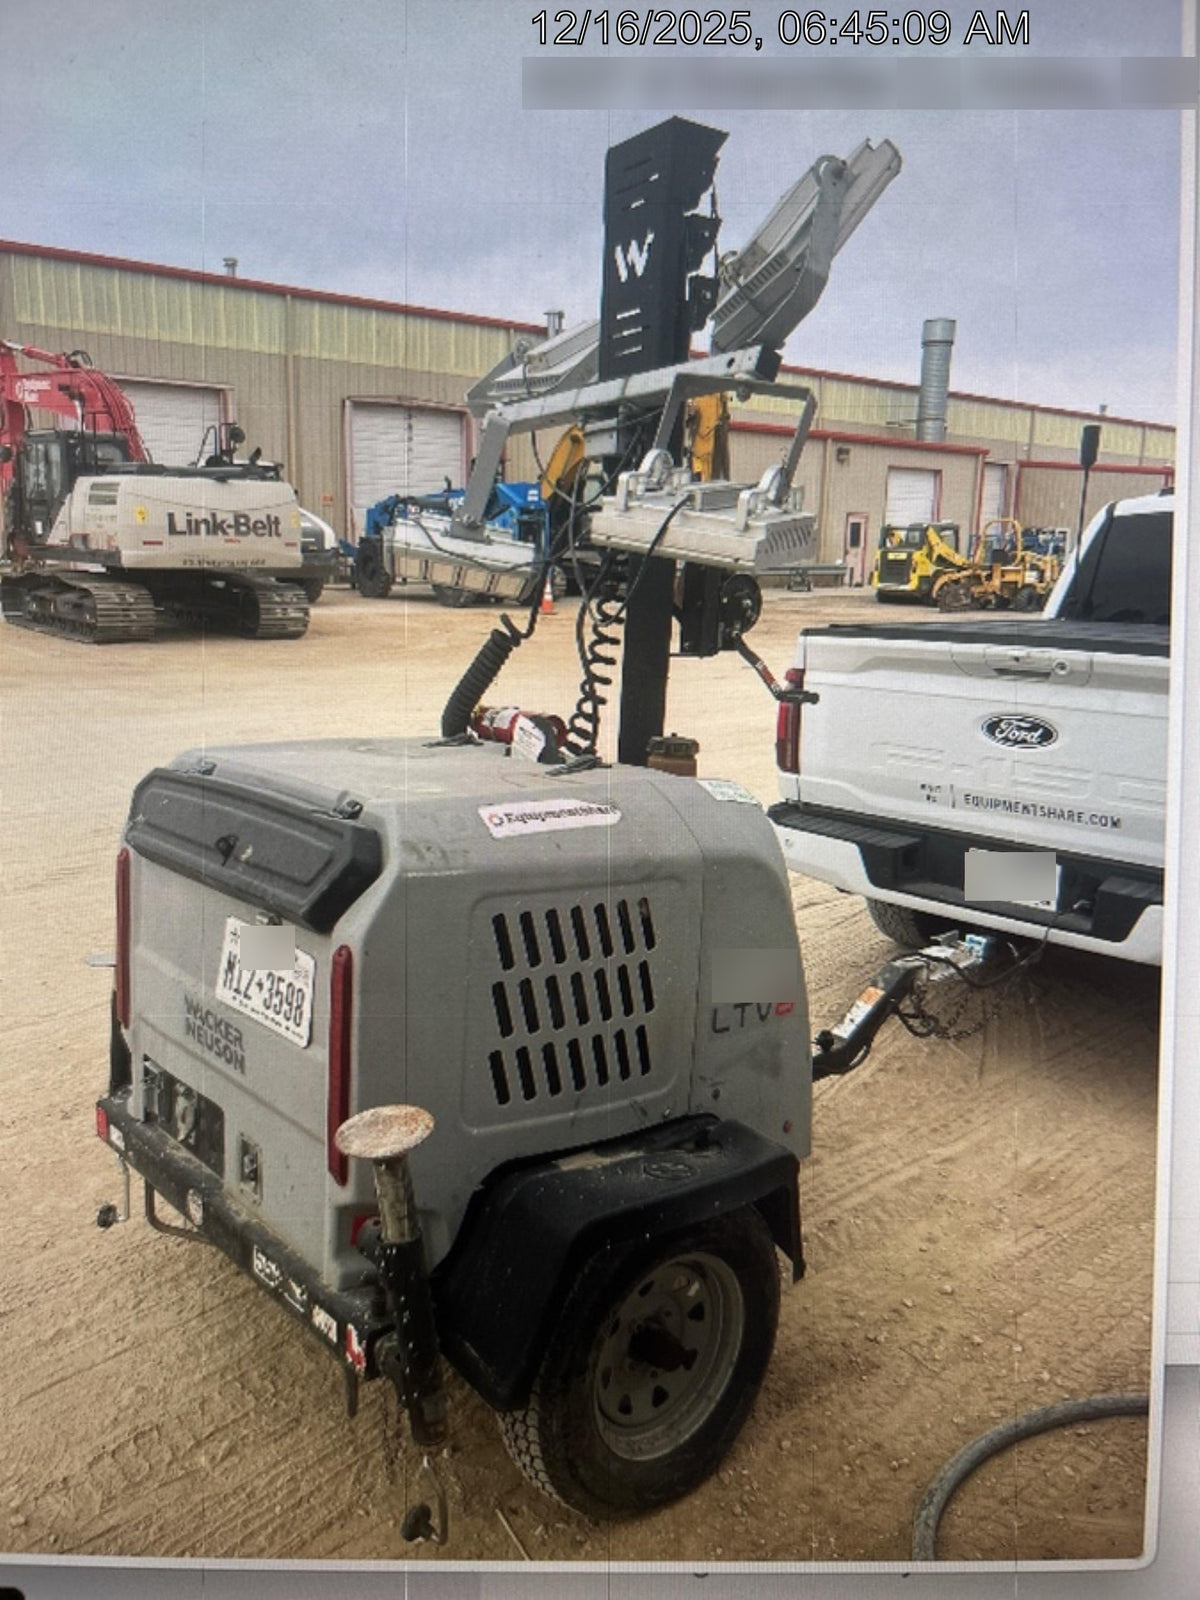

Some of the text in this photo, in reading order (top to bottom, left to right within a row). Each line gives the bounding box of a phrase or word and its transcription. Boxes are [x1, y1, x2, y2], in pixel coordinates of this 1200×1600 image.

[167, 511, 282, 538] Link-Belt
[995, 719, 1043, 743] Ford
[963, 793, 1122, 829] EQUIPMENTSHARE.COM
[184, 993, 245, 1053] WACKER
[185, 1016, 246, 1075] NEUSON
